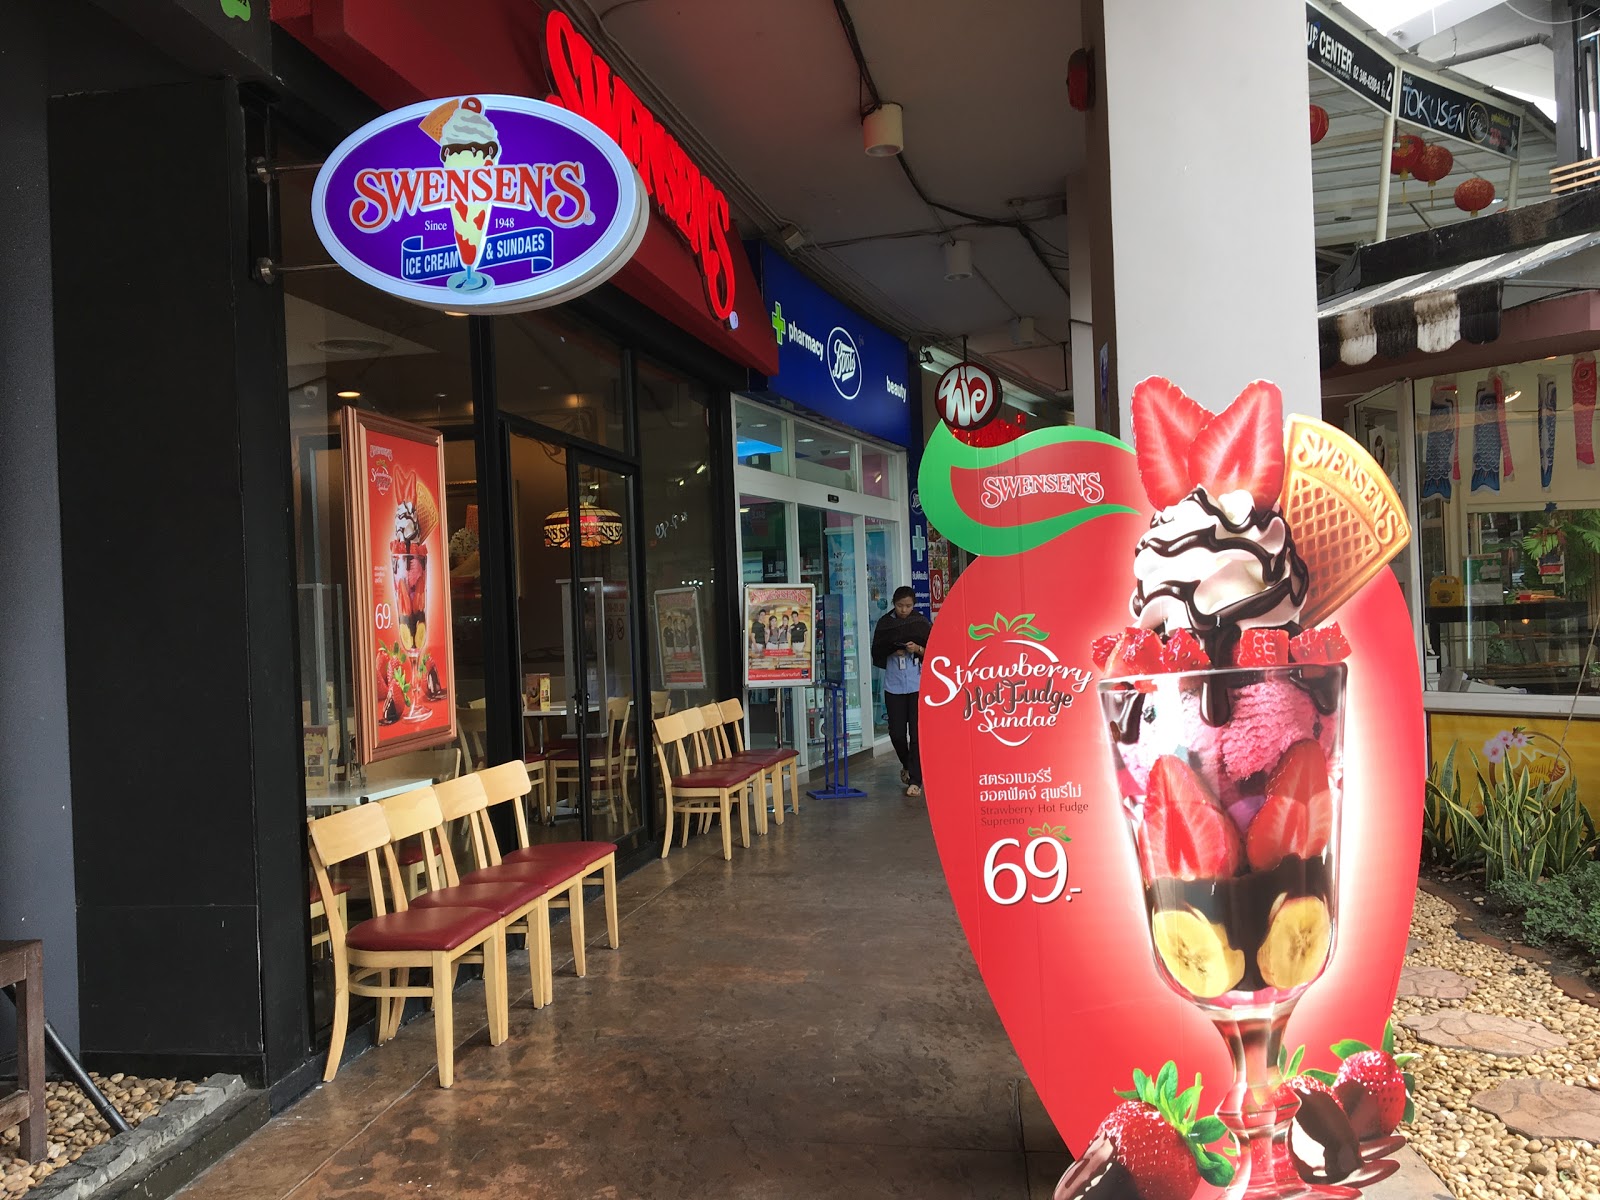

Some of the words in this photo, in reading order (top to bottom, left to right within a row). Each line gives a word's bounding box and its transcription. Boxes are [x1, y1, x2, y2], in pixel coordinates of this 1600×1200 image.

[1319, 31, 1353, 74] CENTER
[1385, 71, 1393, 102] 2
[1402, 85, 1466, 134] TOKUSEN
[350, 161, 587, 231] SWENSEN'S
[424, 219, 448, 231] Since
[494, 217, 515, 229] 1948
[405, 256, 421, 276] ICE
[424, 250, 459, 273] CREAM
[485, 242, 494, 260] &
[496, 232, 545, 258] SUNDAES
[788, 320, 824, 362] pharmacy
[832, 338, 856, 383] Boots
[886, 374, 907, 403] beauty
[980, 472, 1105, 509] SWENSEN'S
[1292, 427, 1399, 546] SWENSEN'S
[924, 653, 1094, 707] Strawberry
[963, 680, 1004, 721] Hot
[1002, 678, 1074, 716] Fudge
[977, 706, 1058, 733] Sundae
[978, 766, 1053, 786] สตรอเบอร์รี่
[1040, 781, 1082, 802] สุพรีโม่
[980, 804, 1034, 816] Strawberry
[1038, 804, 1056, 813] Hot
[1059, 801, 1089, 814] Fudge
[980, 816, 1025, 829] Supremo
